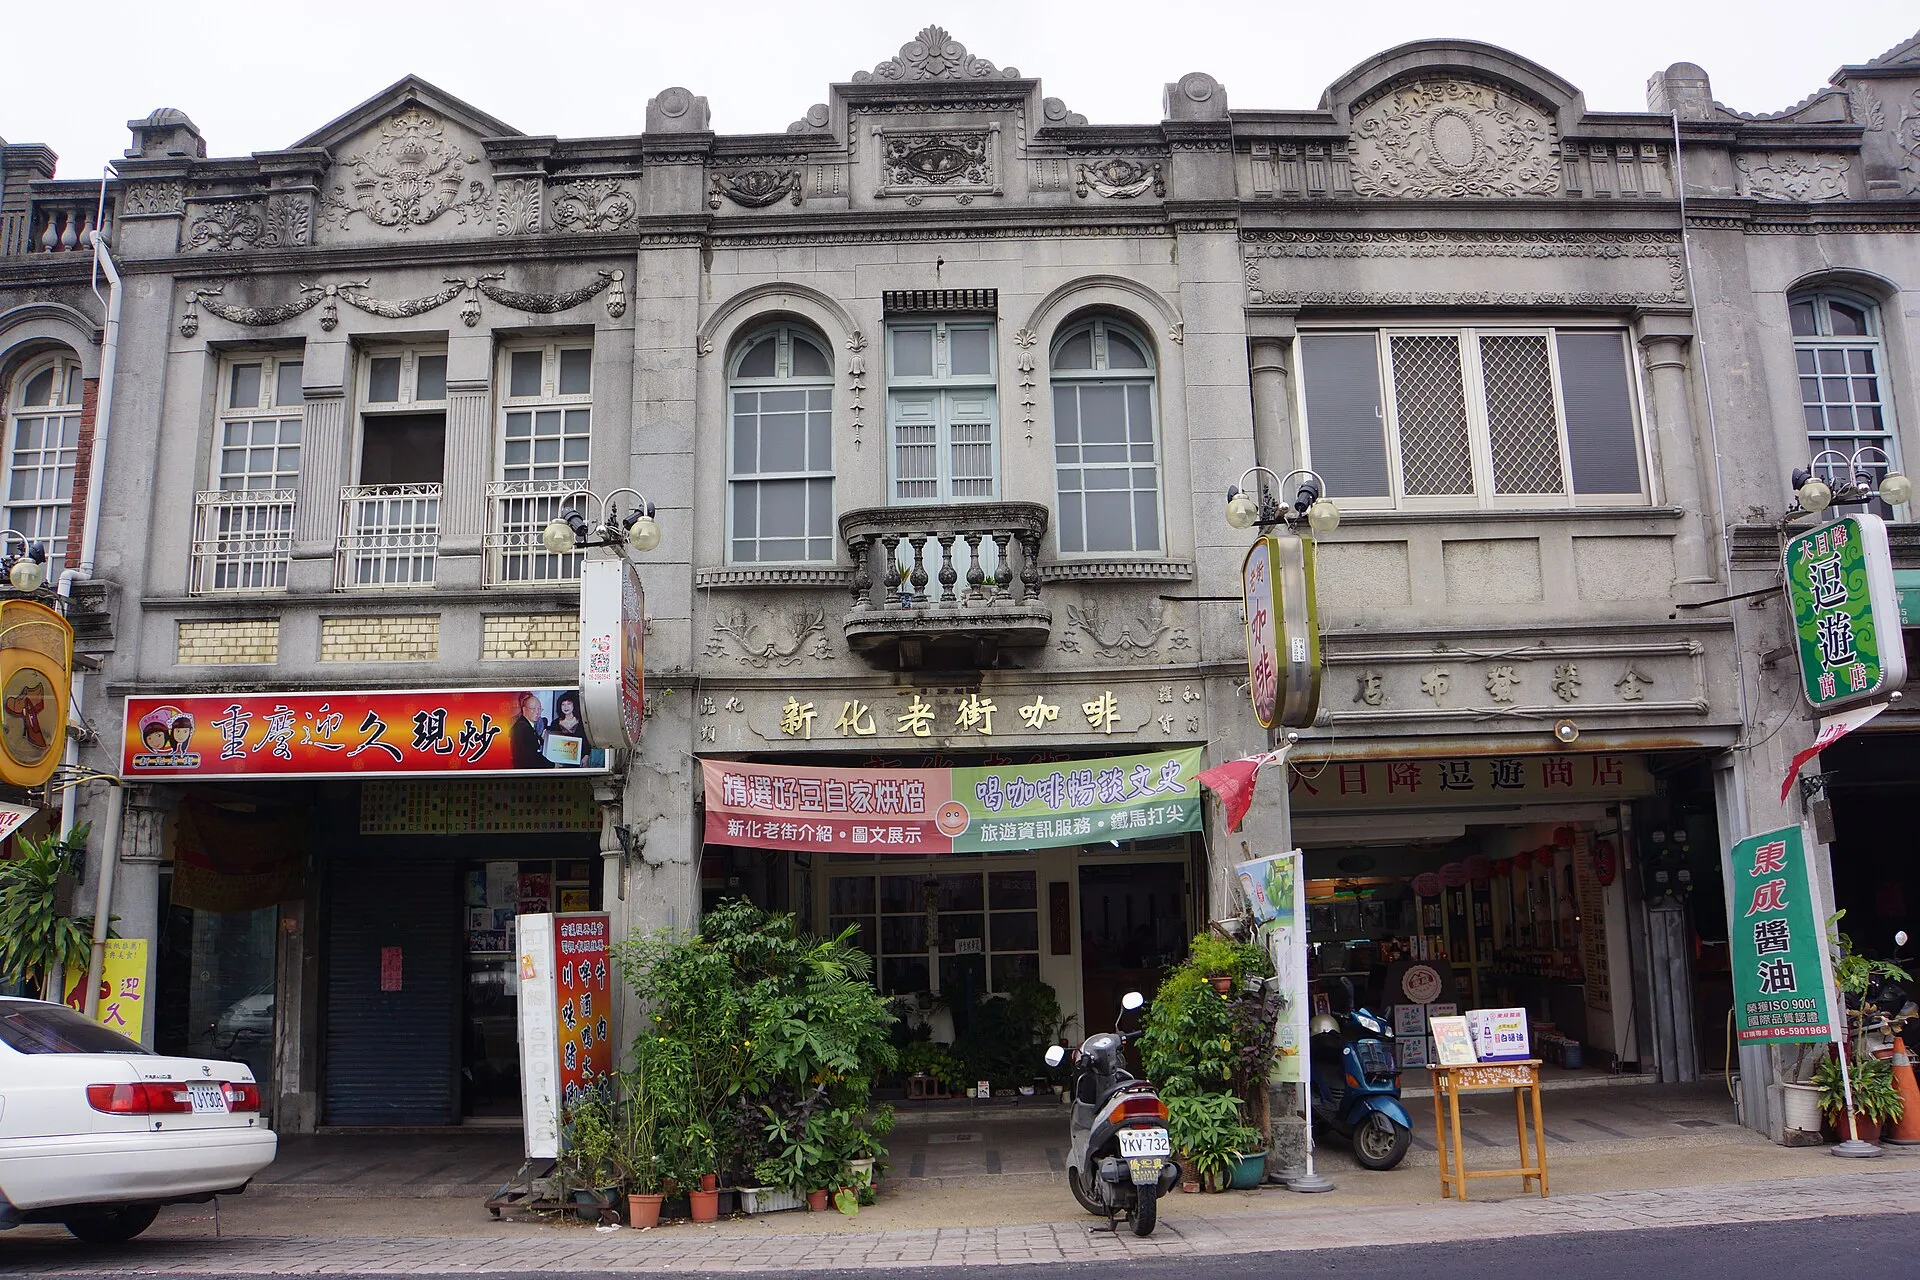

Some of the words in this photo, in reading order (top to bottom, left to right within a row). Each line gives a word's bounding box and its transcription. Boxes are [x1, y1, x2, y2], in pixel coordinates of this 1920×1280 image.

[1798, 524, 1848, 565] 大目降
[1808, 551, 1857, 670] 逗遊
[1251, 599, 1272, 699] 咖啡
[1818, 662, 1868, 700] 商店
[780, 690, 1122, 740] 新化老街咖啡
[722, 771, 925, 814] 精選好豆自家烘焙
[975, 760, 1186, 812] 喝咖啡暢談文史
[1744, 840, 1798, 995] 東成醬油
[1791, 998, 1817, 1010] 9001
[1774, 1026, 1828, 1036] 06-5901968
[1121, 1138, 1169, 1152] YKV-732
